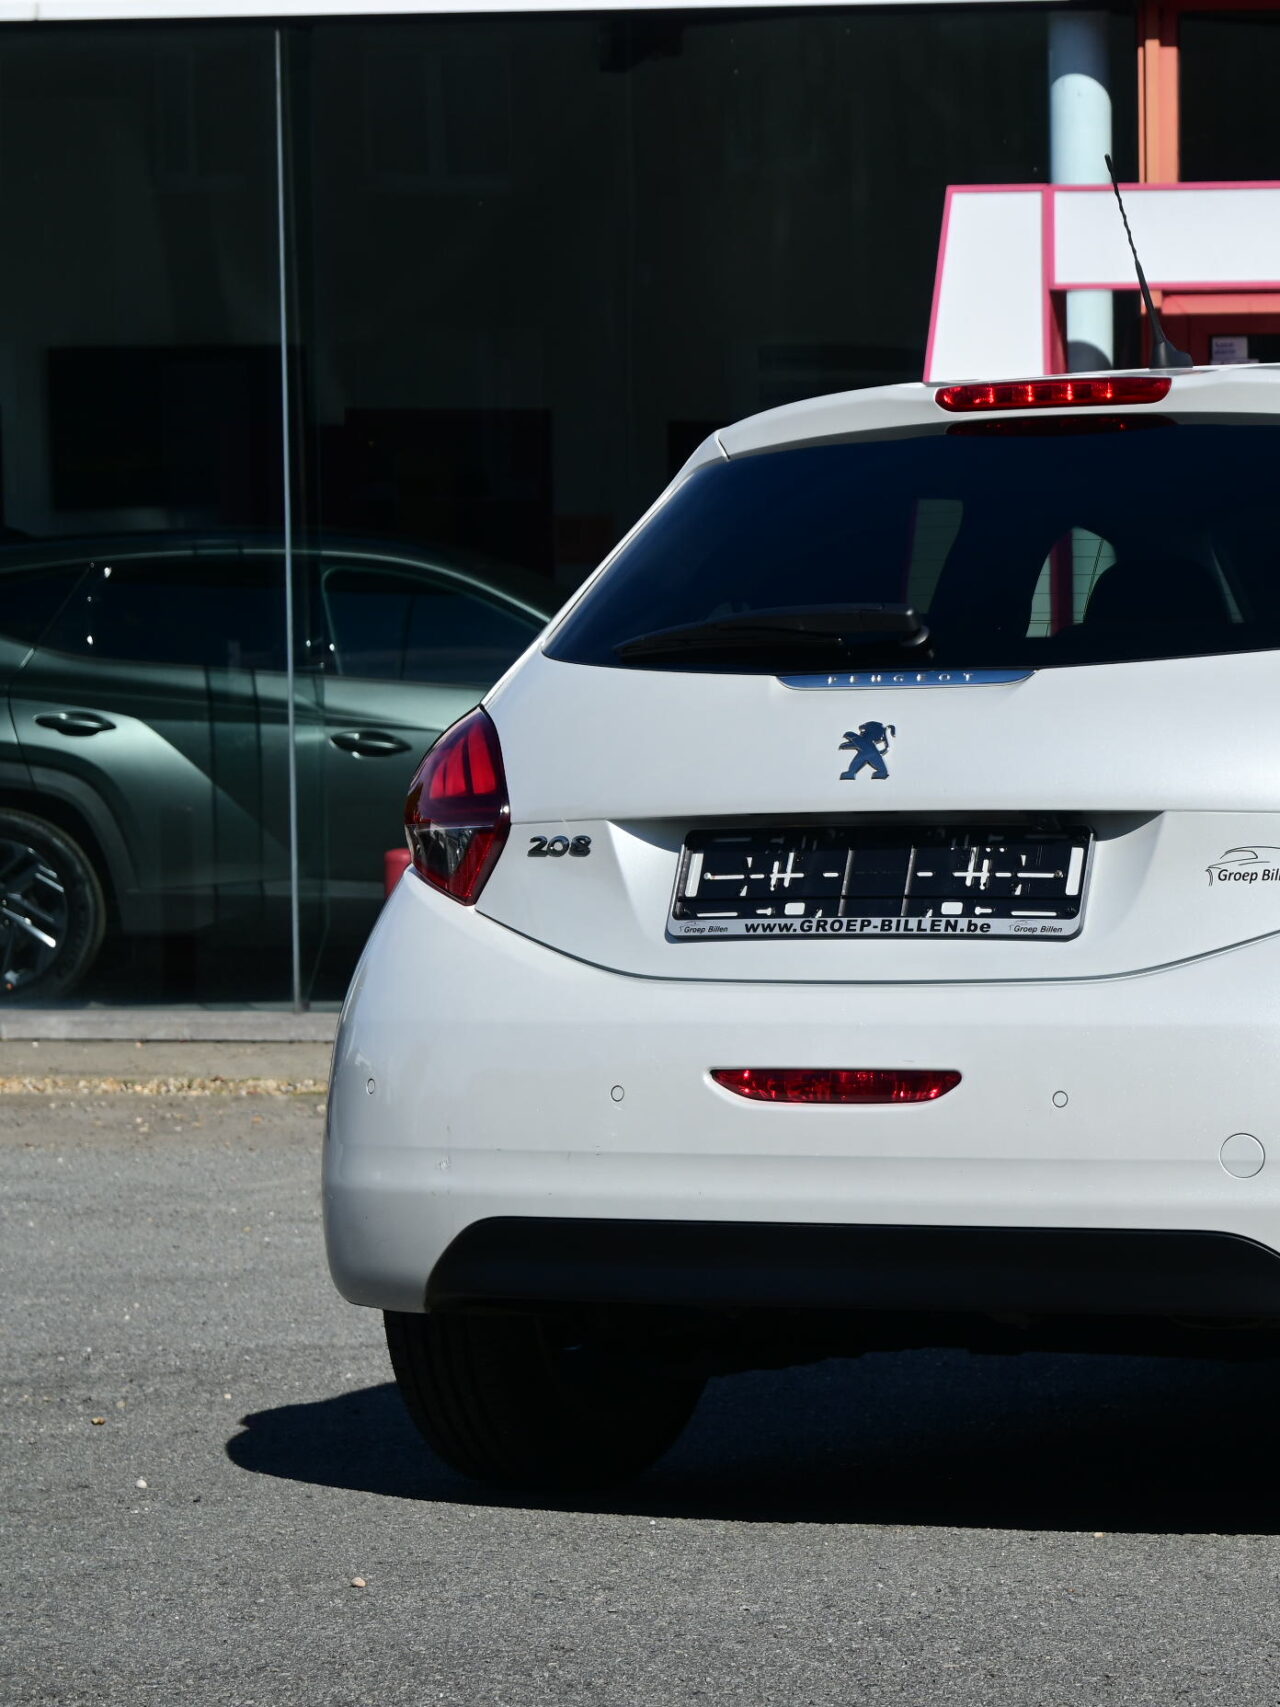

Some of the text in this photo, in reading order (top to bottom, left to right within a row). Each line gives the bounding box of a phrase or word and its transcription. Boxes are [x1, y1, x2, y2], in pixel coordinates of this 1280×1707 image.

[527, 834, 592, 859] 208
[1218, 869, 1258, 884] Groep
[684, 925, 729, 934] Groep Billen
[744, 919, 992, 933] www.GROEP-BILLEN.be
[1013, 925, 1063, 934] Groep Billen
